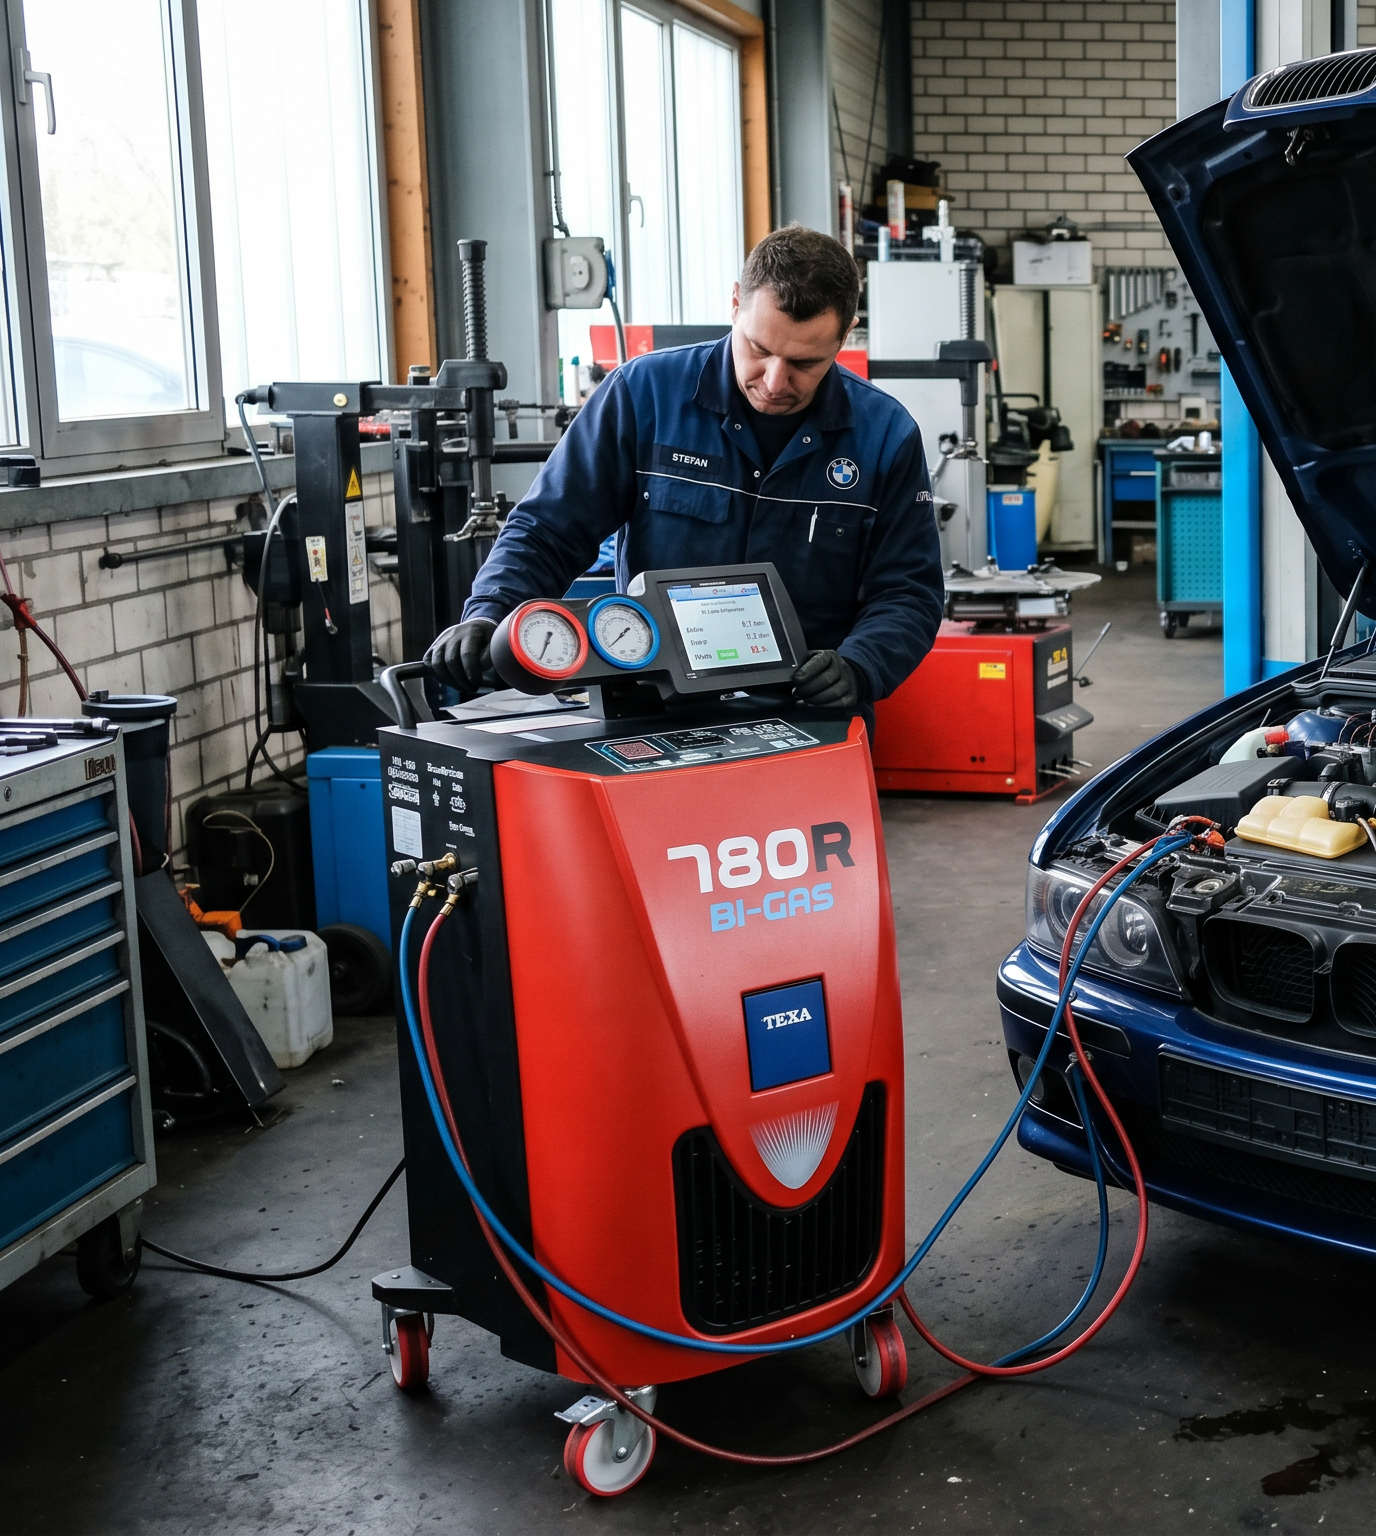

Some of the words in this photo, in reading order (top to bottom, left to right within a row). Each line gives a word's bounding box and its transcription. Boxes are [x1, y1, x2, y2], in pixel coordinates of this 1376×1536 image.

[672, 452, 708, 468] STEFAN
[667, 821, 855, 894] 780R
[710, 882, 835, 933] BI-GAS
[762, 1007, 812, 1030] TEXA
